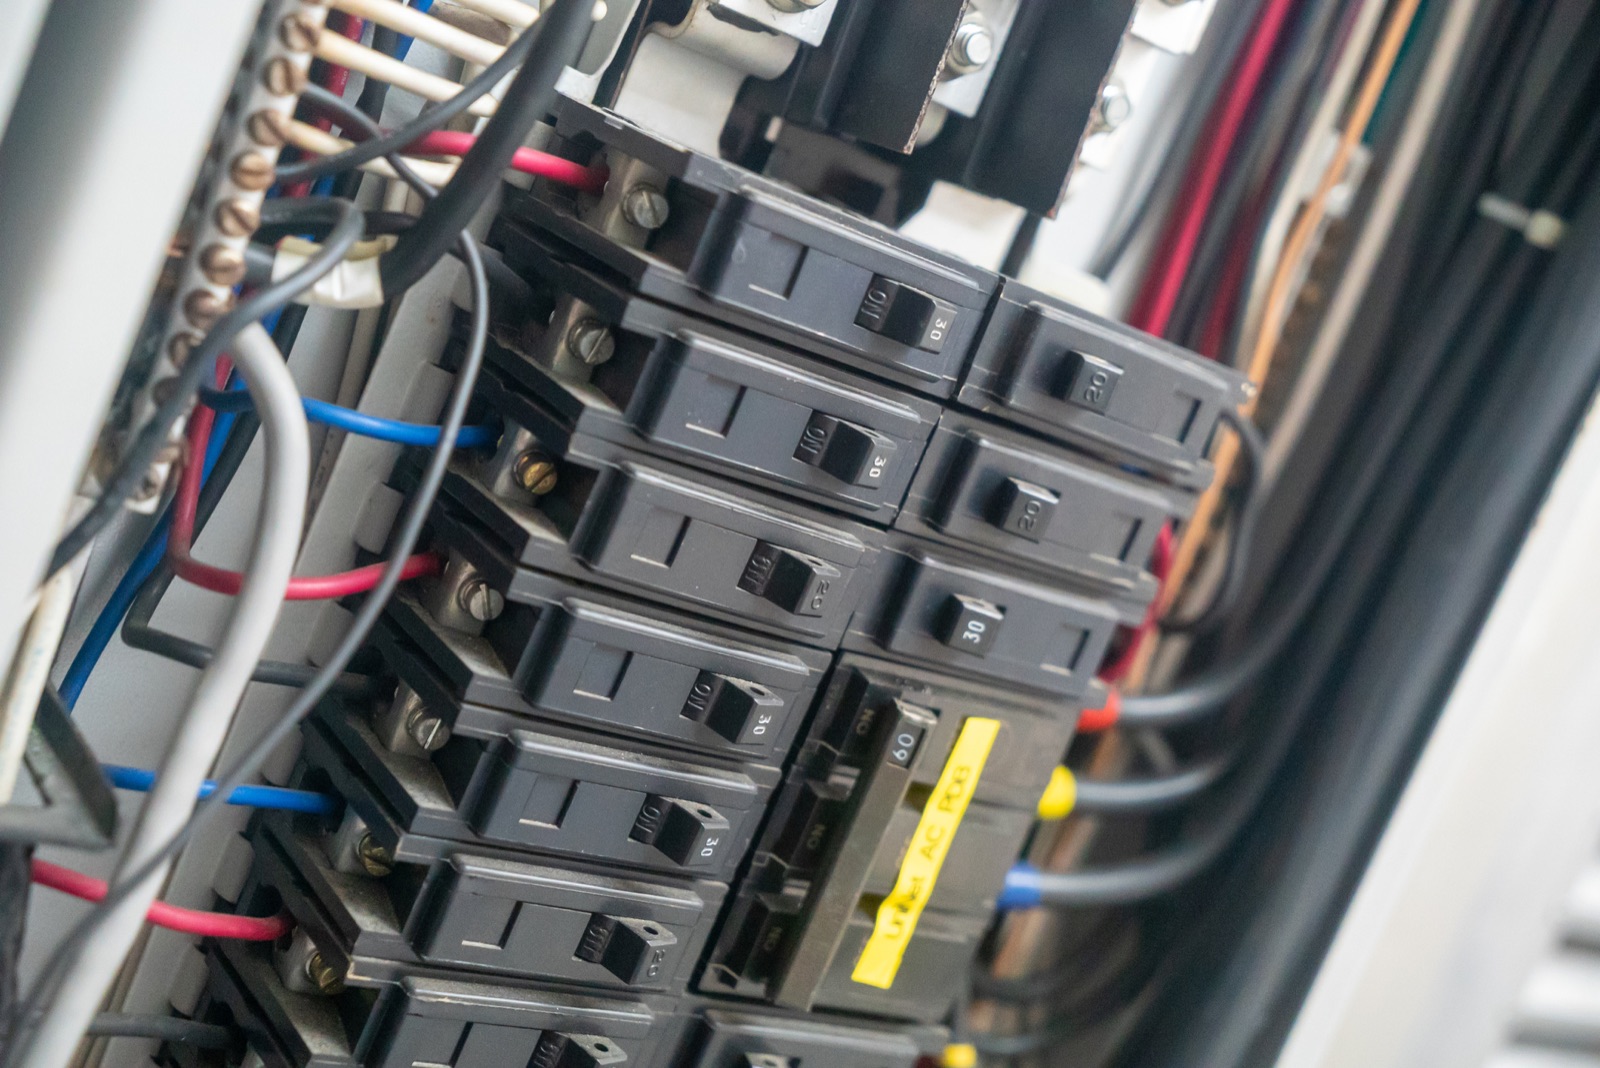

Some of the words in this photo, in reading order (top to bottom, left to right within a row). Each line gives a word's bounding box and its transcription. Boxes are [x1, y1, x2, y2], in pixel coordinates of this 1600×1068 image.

[861, 288, 887, 319] ON
[929, 317, 948, 341] 30
[1083, 371, 1107, 402] 20
[800, 426, 826, 454] ON
[868, 455, 887, 478] 30
[1017, 500, 1041, 532] 20
[810, 579, 830, 610] 20
[962, 620, 986, 643] 30
[687, 682, 711, 711] ON
[752, 714, 772, 735] 30
[892, 733, 915, 761] 60
[635, 804, 661, 833] ON
[920, 824, 946, 861] AC
[937, 765, 971, 813] PDB
[700, 837, 719, 856] 30
[646, 948, 666, 977] 20
